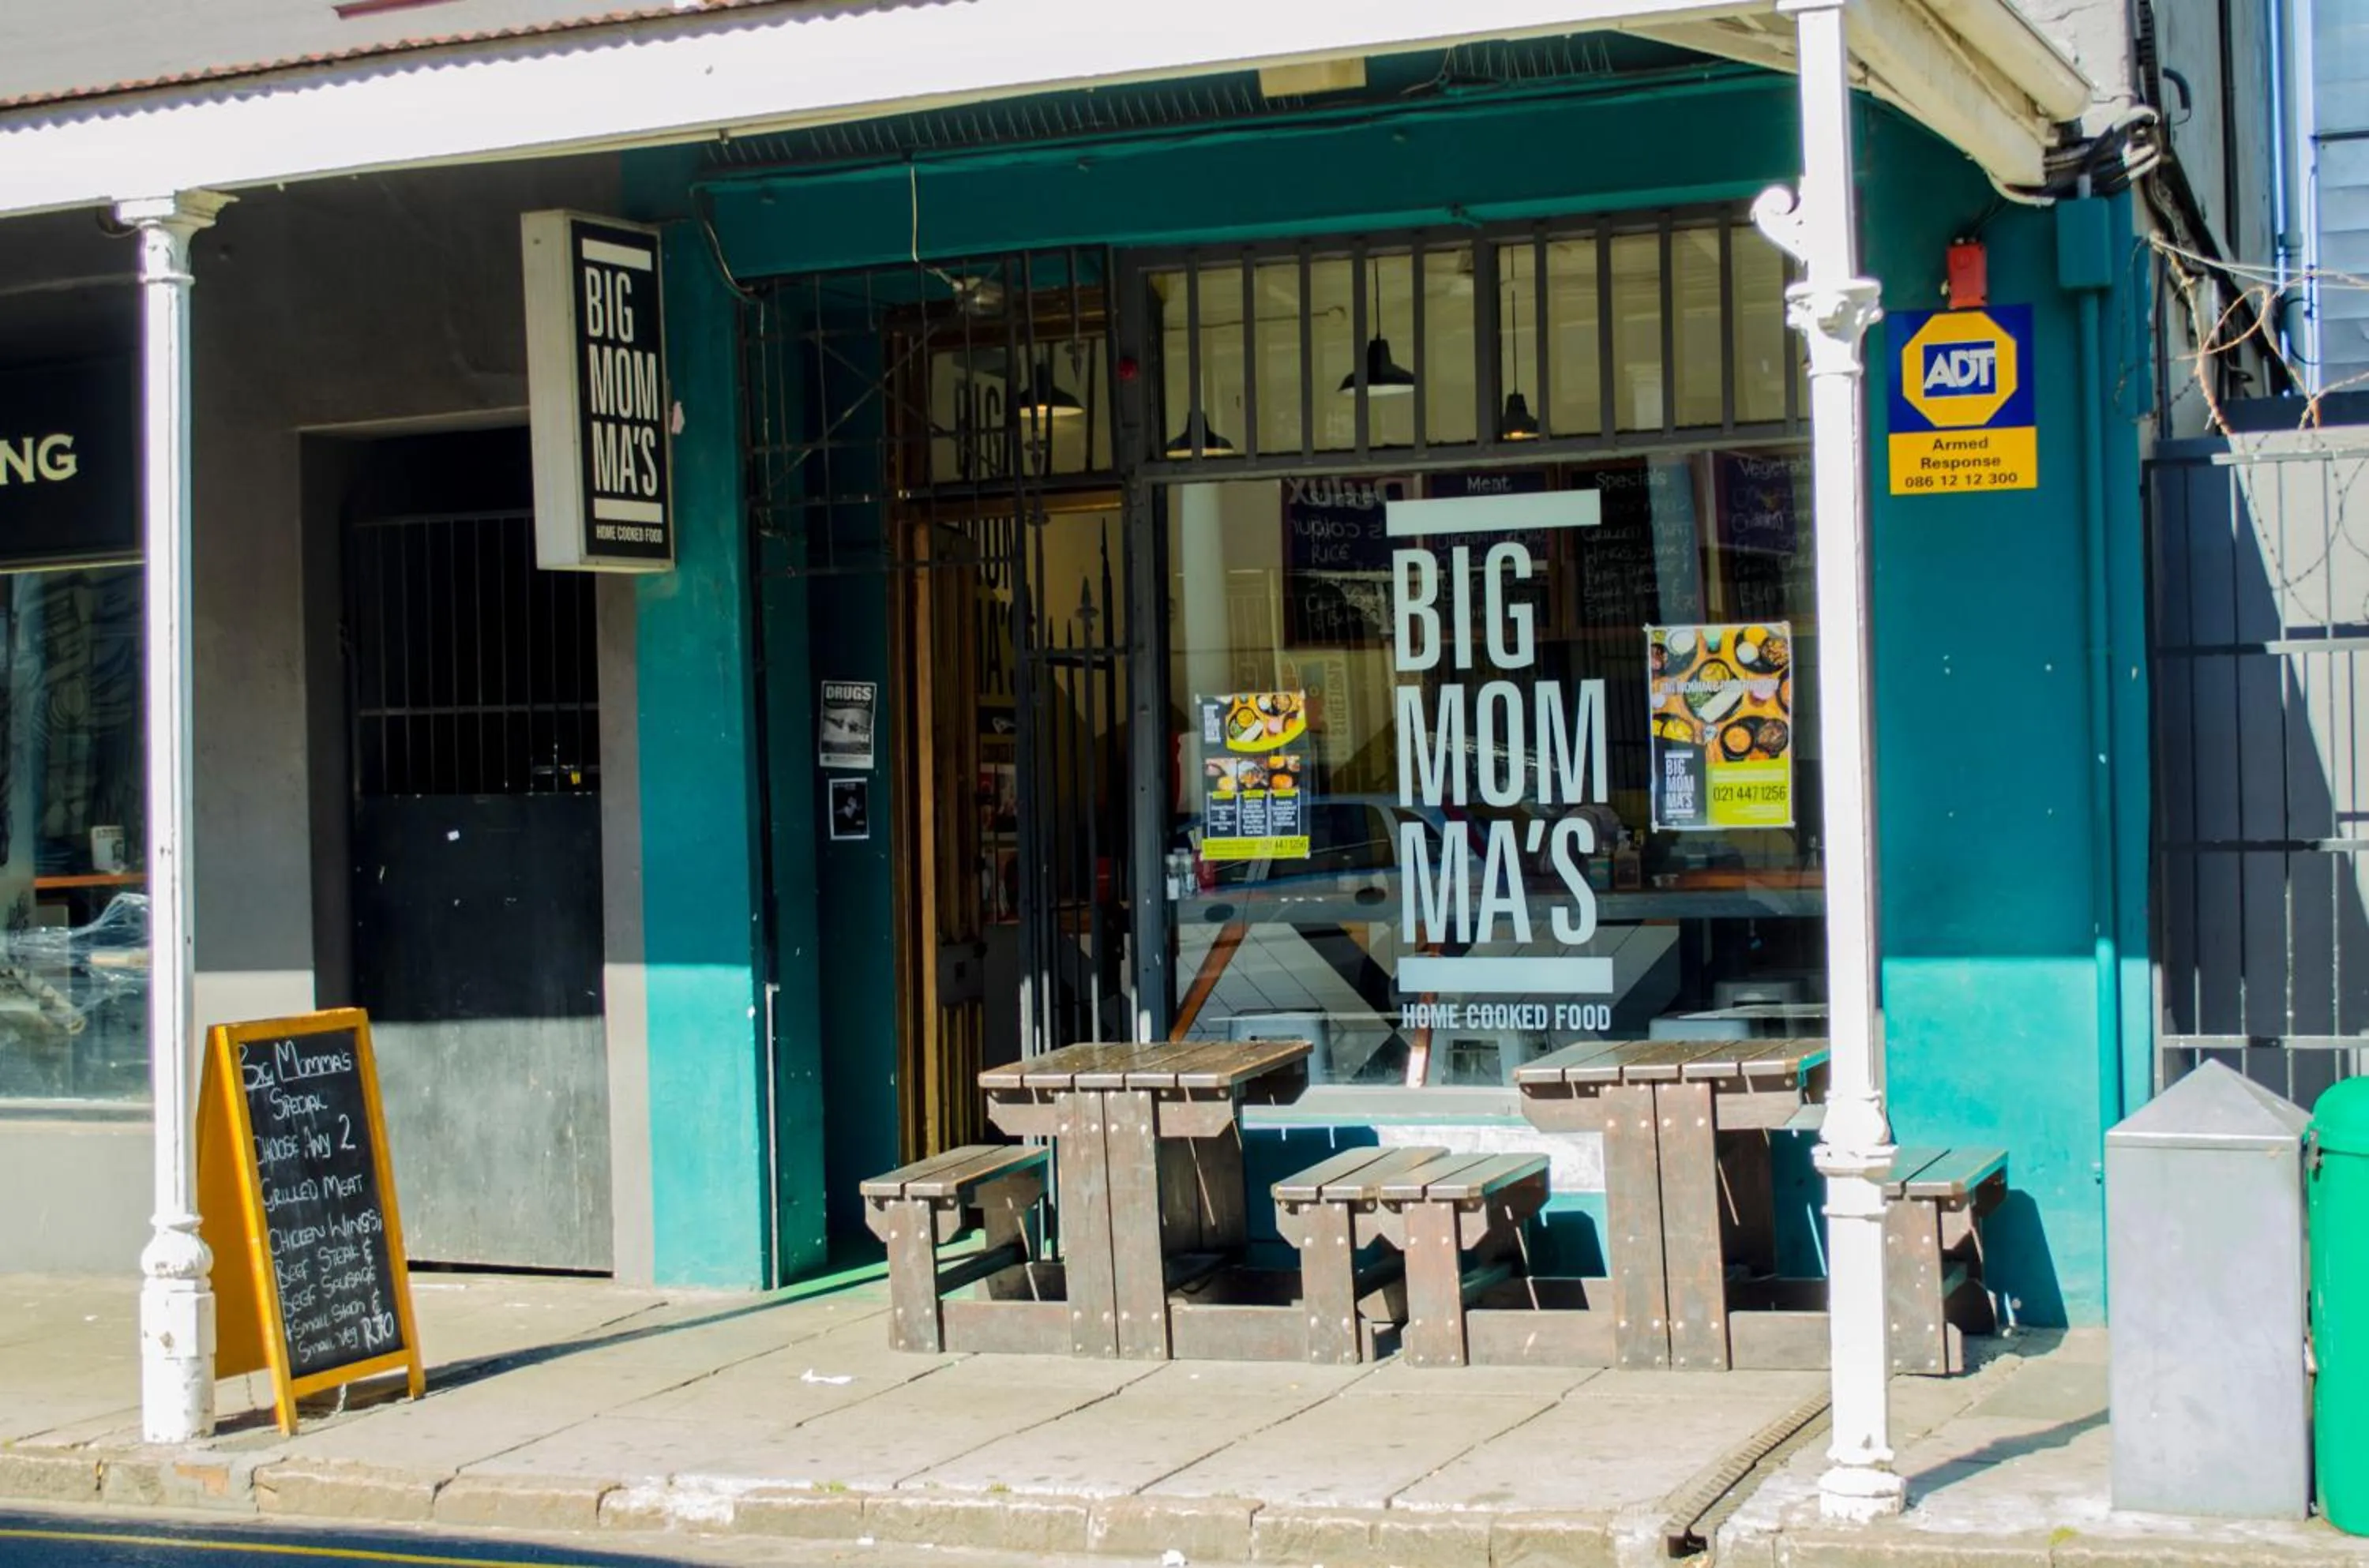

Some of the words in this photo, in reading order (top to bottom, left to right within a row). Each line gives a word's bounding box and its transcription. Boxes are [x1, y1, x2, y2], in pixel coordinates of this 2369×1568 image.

[584, 266, 634, 343] BIG
[588, 343, 659, 421] MOM
[1924, 348, 1995, 389] ADT
[1933, 436, 1989, 451] Armed
[591, 422, 658, 497] MA'S
[1920, 456, 2001, 471] Response
[1466, 475, 1512, 492] Meat
[1594, 468, 1667, 492] Specials
[1905, 476, 1934, 488] 086
[1940, 475, 1957, 486] 12
[1965, 474, 1982, 486] 12
[1988, 472, 2018, 485] 300
[595, 524, 616, 540] HOME
[617, 525, 644, 542] COOKED
[644, 527, 663, 543] FOOD
[1392, 542, 1534, 672] BIG
[825, 685, 872, 701] DRUGS
[1396, 678, 1609, 808] MOM
[1665, 758, 1686, 775] BIG
[1665, 775, 1694, 792] MOM
[1713, 787, 1733, 801] 021
[1736, 786, 1757, 801] 447
[1761, 785, 1786, 800] 1256
[1401, 817, 1597, 946] MA'S
[1402, 1003, 1460, 1029] HOME
[1466, 1003, 1547, 1030] COOKED
[1555, 1003, 1611, 1031] FOOD
[339, 1114, 355, 1150] 2
[261, 1177, 318, 1212] GRILLED
[323, 1174, 362, 1199] MEAT
[317, 1244, 361, 1272] STEAK
